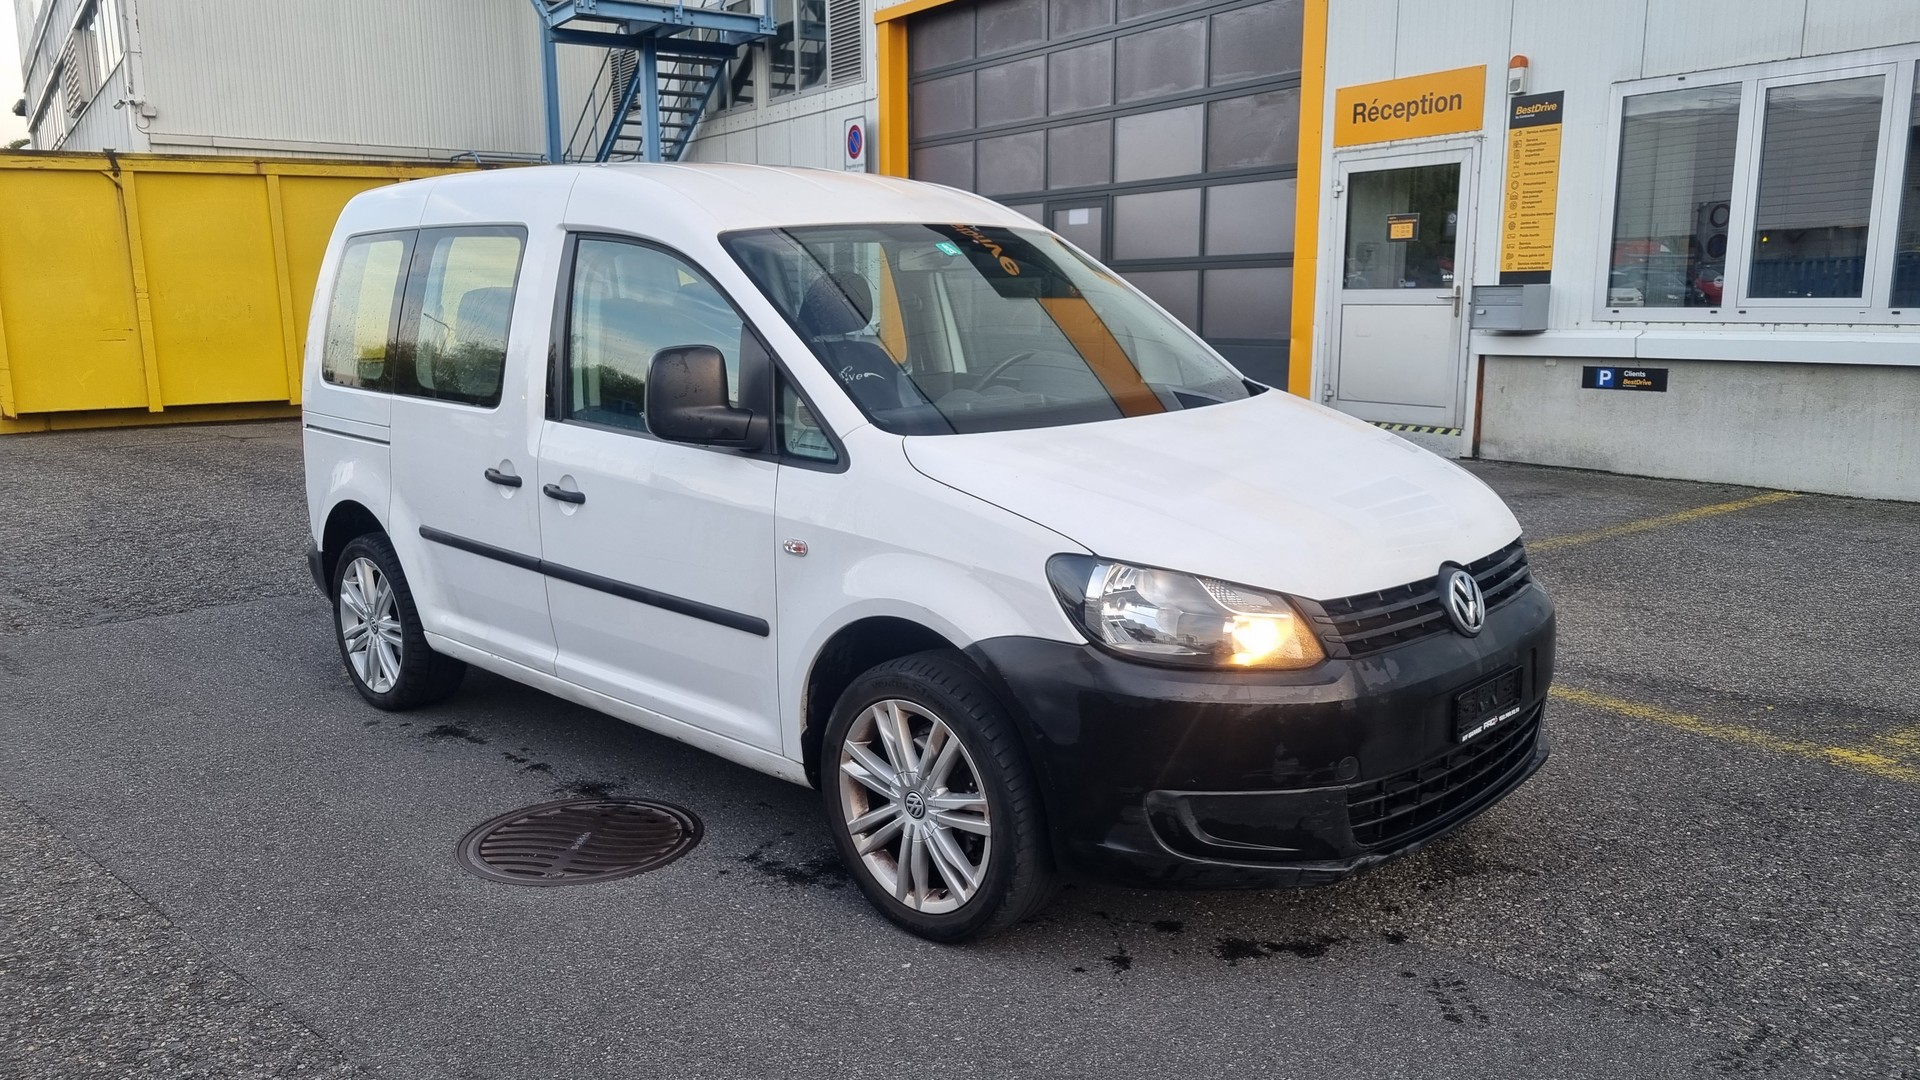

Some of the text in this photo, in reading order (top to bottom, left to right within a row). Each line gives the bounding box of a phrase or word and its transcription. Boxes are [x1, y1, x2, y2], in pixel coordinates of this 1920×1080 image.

[1352, 92, 1462, 124] Réception
[1515, 101, 1558, 115] BestDrive
[1599, 369, 1612, 386] P
